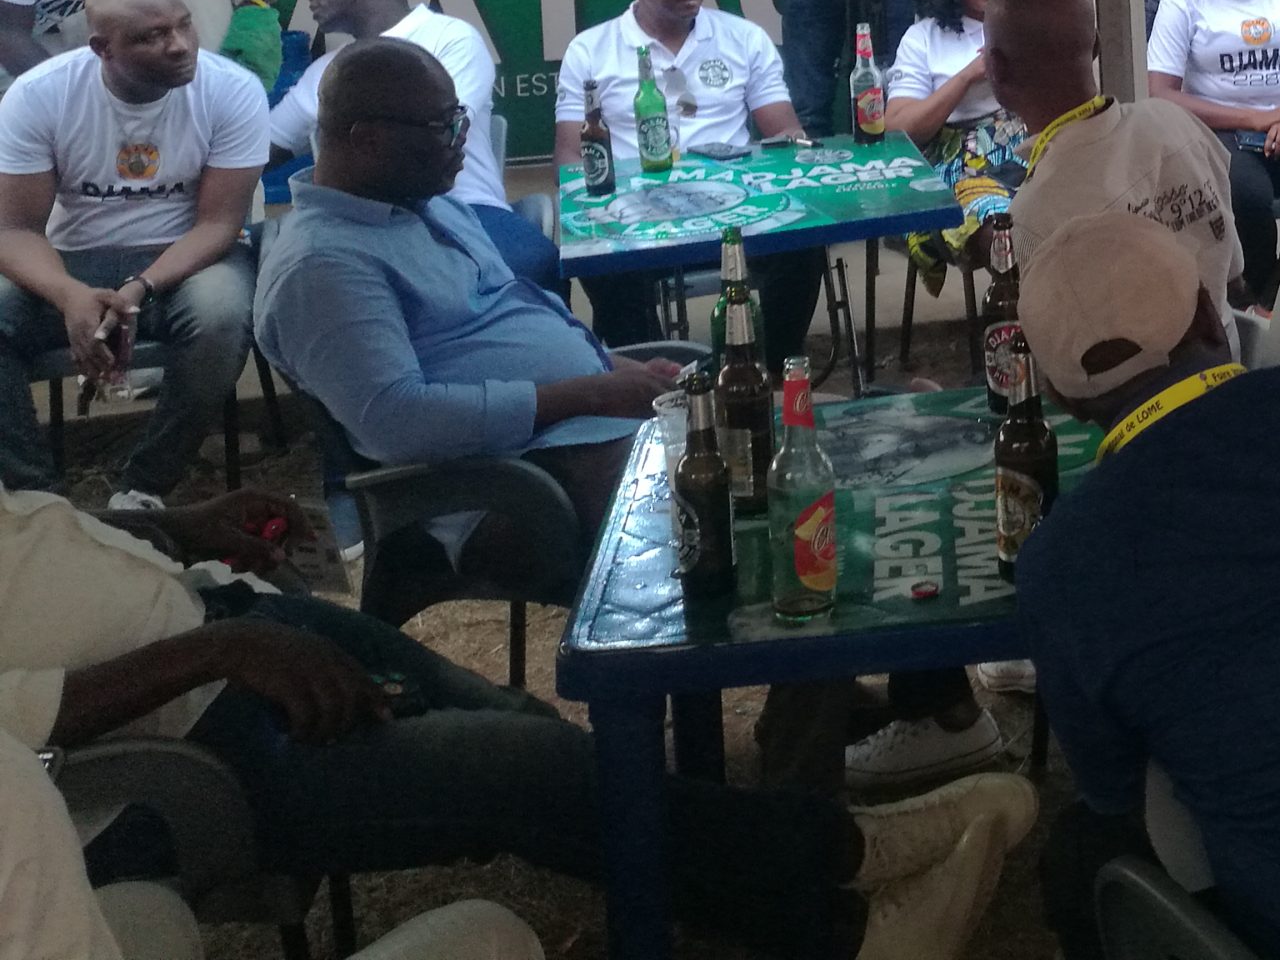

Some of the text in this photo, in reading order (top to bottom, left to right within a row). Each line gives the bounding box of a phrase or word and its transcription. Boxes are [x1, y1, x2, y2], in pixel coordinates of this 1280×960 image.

[1233, 73, 1280, 86] 228
[741, 156, 925, 187] DJAMA
[622, 204, 768, 236] LAGER
[1125, 399, 1164, 433] de LOME
[872, 492, 944, 602] LAGER
[951, 478, 1017, 606] DJAMA
